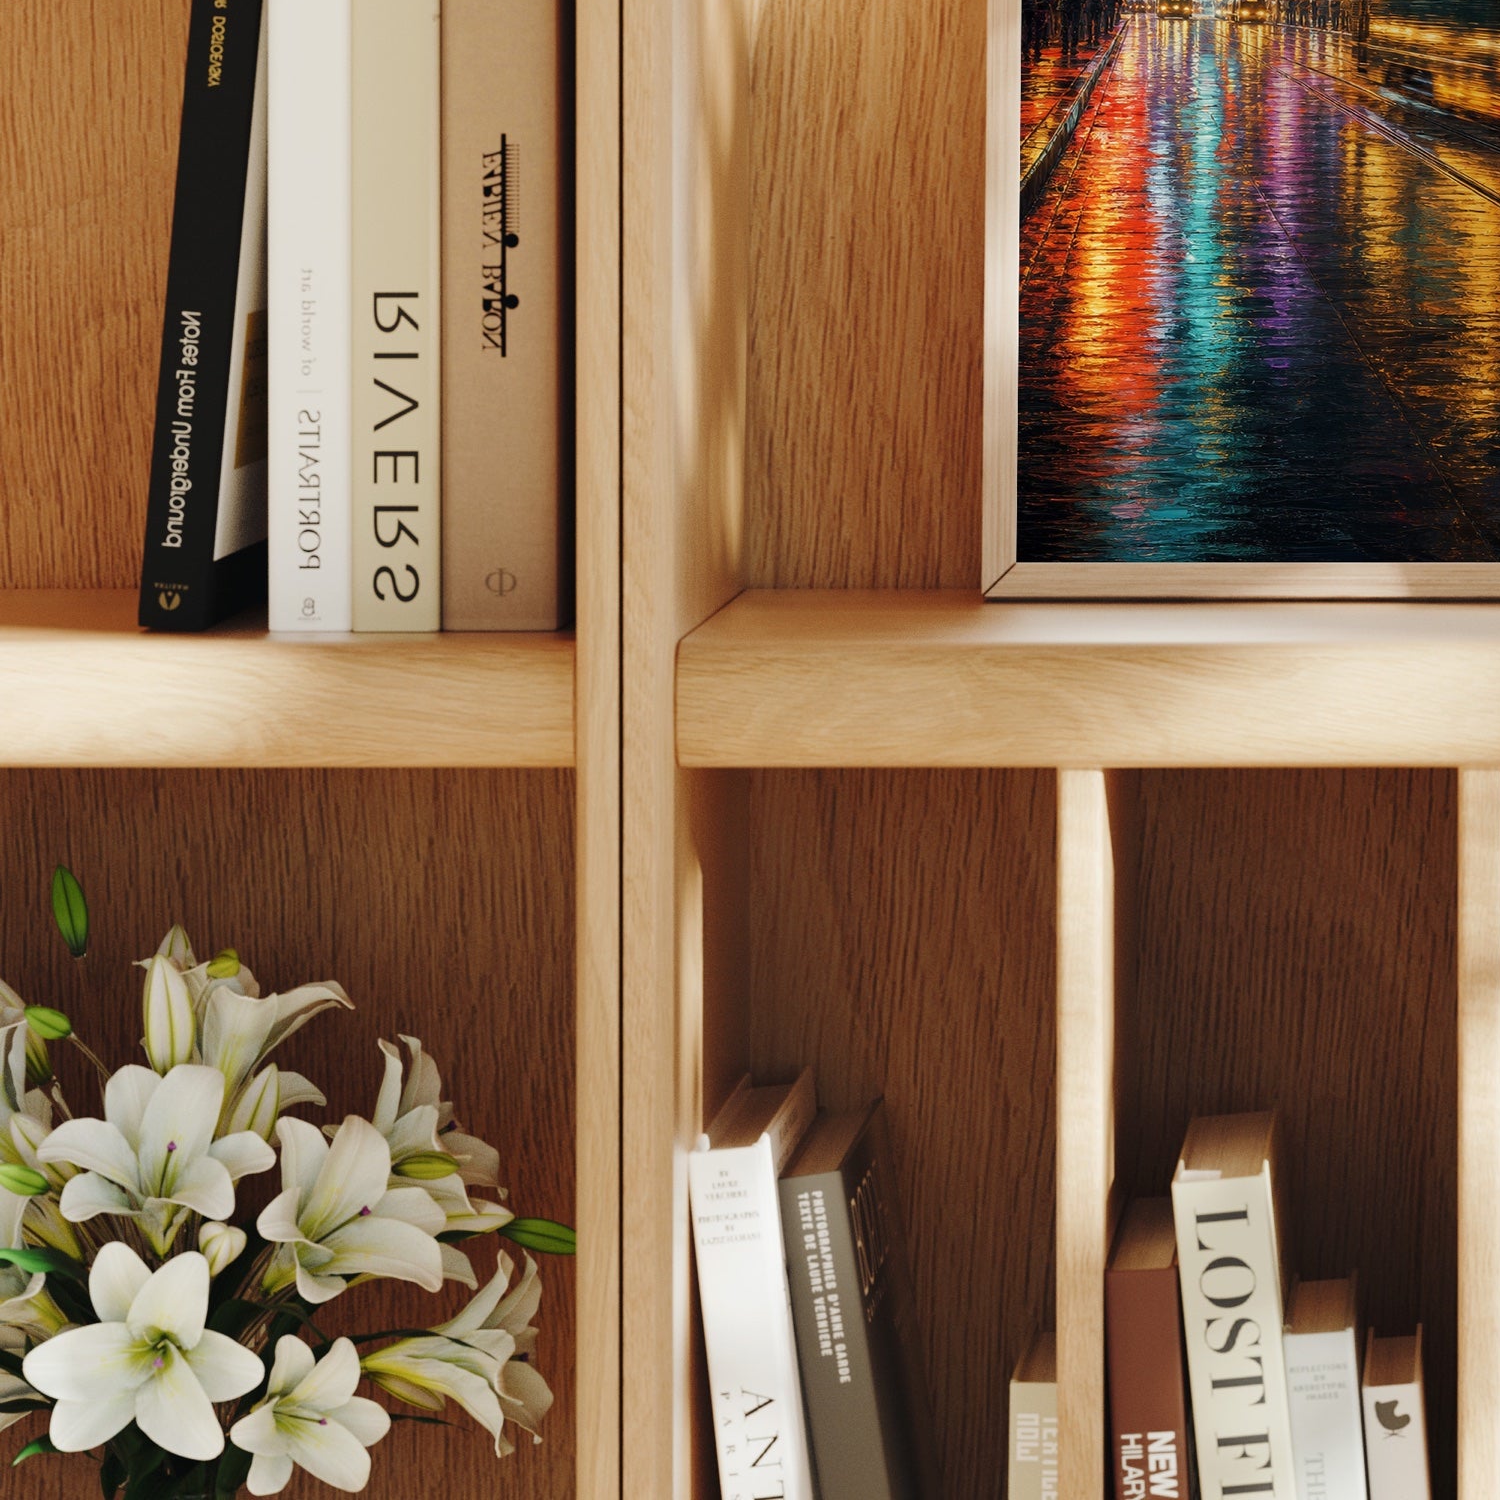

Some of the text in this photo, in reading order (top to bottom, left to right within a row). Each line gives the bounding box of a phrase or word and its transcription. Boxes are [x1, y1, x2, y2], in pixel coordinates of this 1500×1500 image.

[797, 1192, 814, 1230] TEXTE
[803, 1234, 818, 1251] DE
[806, 1254, 824, 1294] LAURE
[1193, 1203, 1267, 1406] LOST
[1147, 1430, 1179, 1499] NEW
